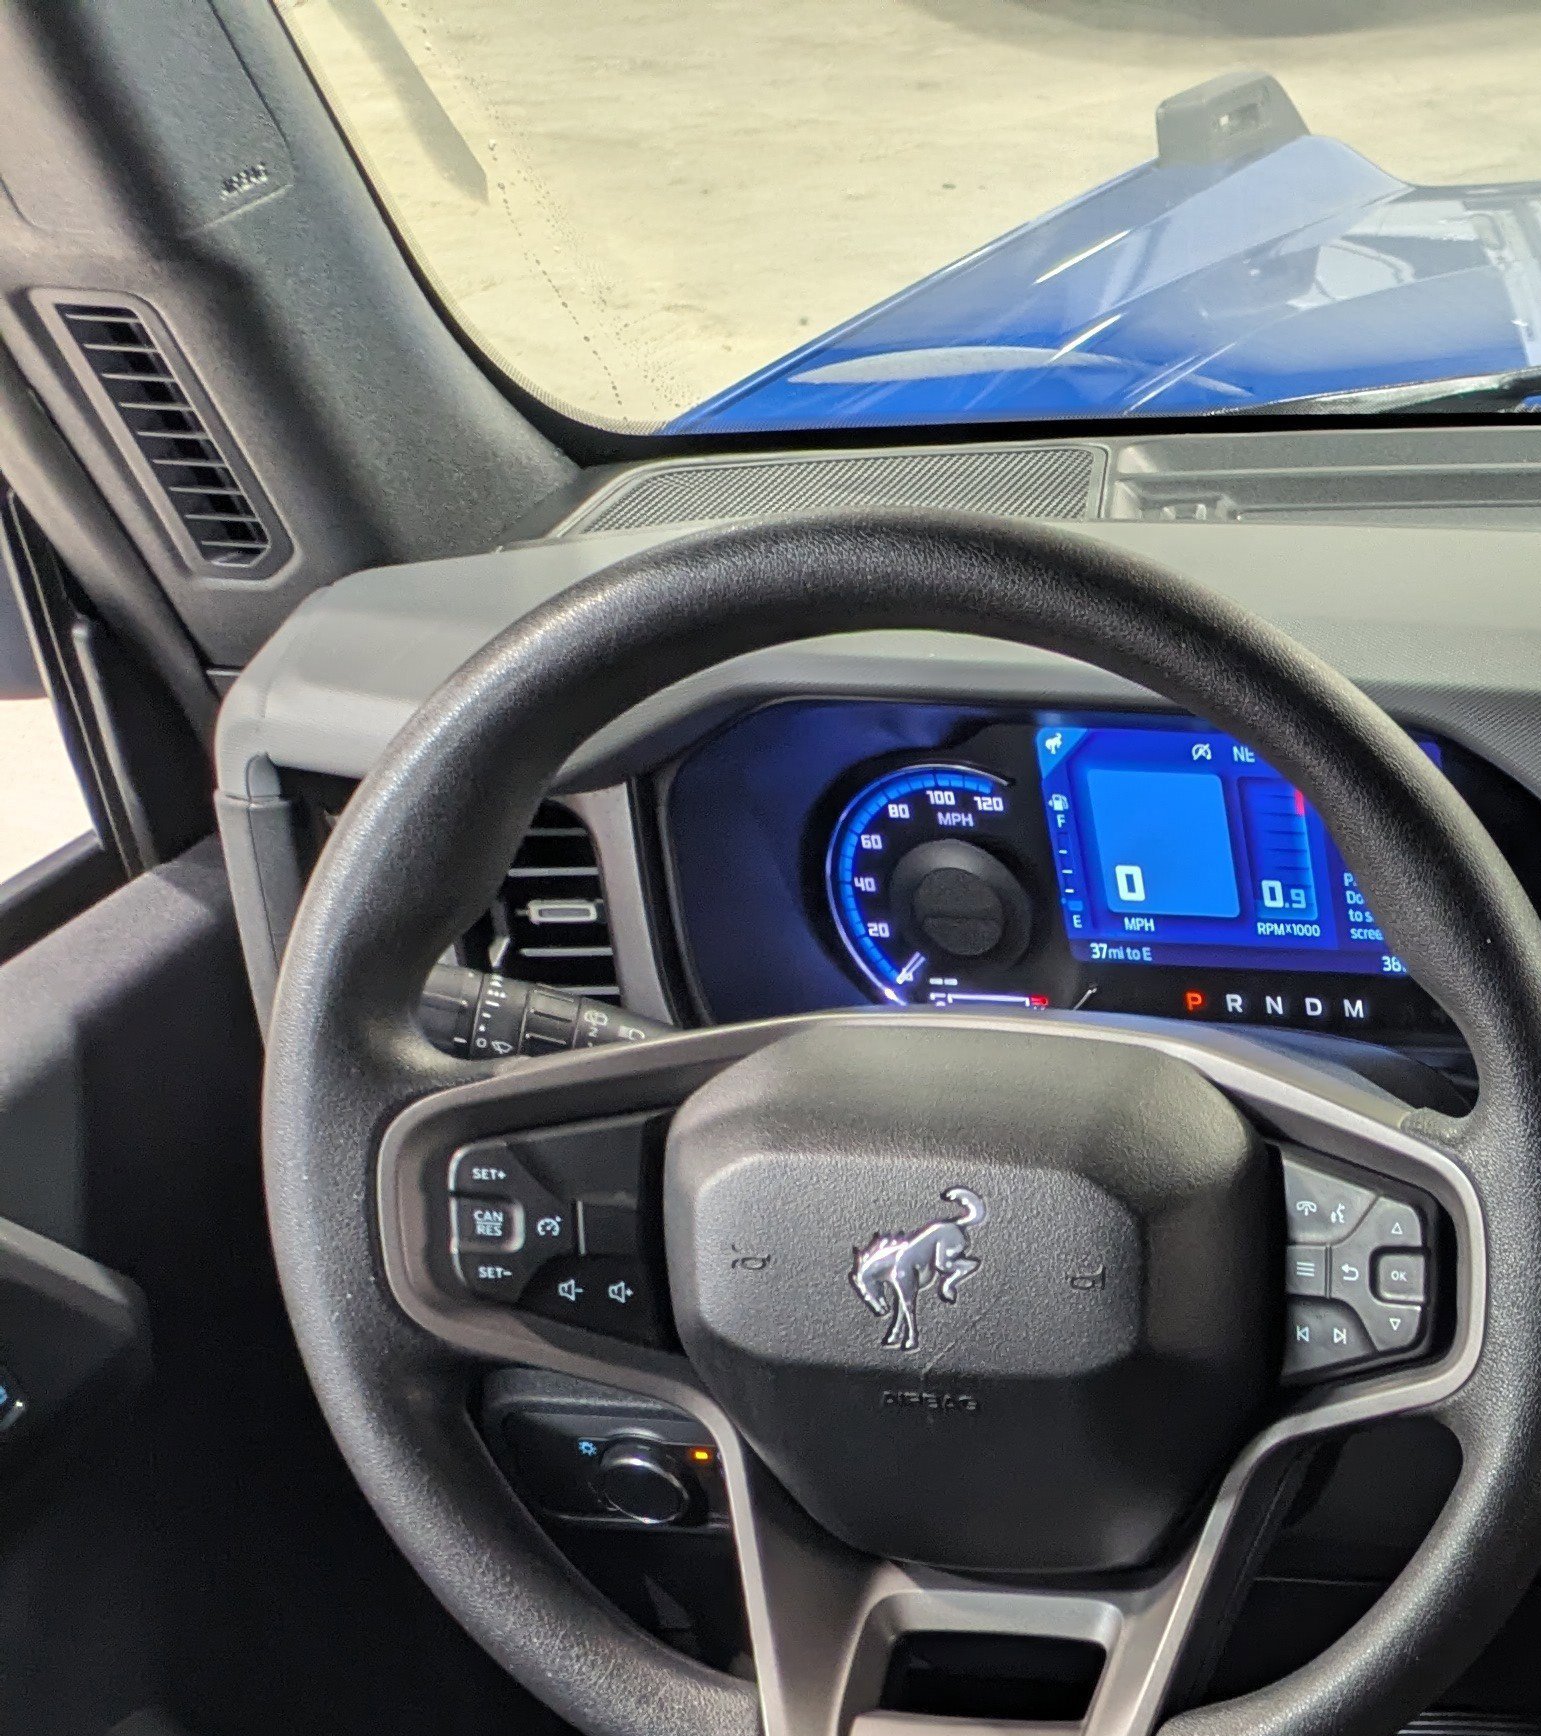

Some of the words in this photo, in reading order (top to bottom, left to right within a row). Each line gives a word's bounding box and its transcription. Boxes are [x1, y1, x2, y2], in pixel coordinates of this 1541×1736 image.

[926, 790, 956, 806] 100
[973, 796, 1004, 812] 120
[888, 803, 910, 819] 80
[937, 812, 974, 827] MPH
[1057, 814, 1066, 828] F
[861, 834, 882, 850] 60
[854, 876, 876, 892] 40
[1115, 864, 1146, 902] 0
[1073, 914, 1083, 929] E
[1124, 917, 1155, 932] MPH
[868, 923, 890, 938] 20
[1185, 991, 1202, 1011] P
[1226, 993, 1243, 1013] R
[1265, 995, 1283, 1015] N
[1305, 997, 1323, 1017] D
[1343, 999, 1364, 1018] M
[474, 1210, 503, 1223] CAN
[476, 1223, 503, 1237] RES
[1390, 1270, 1407, 1282] OK
